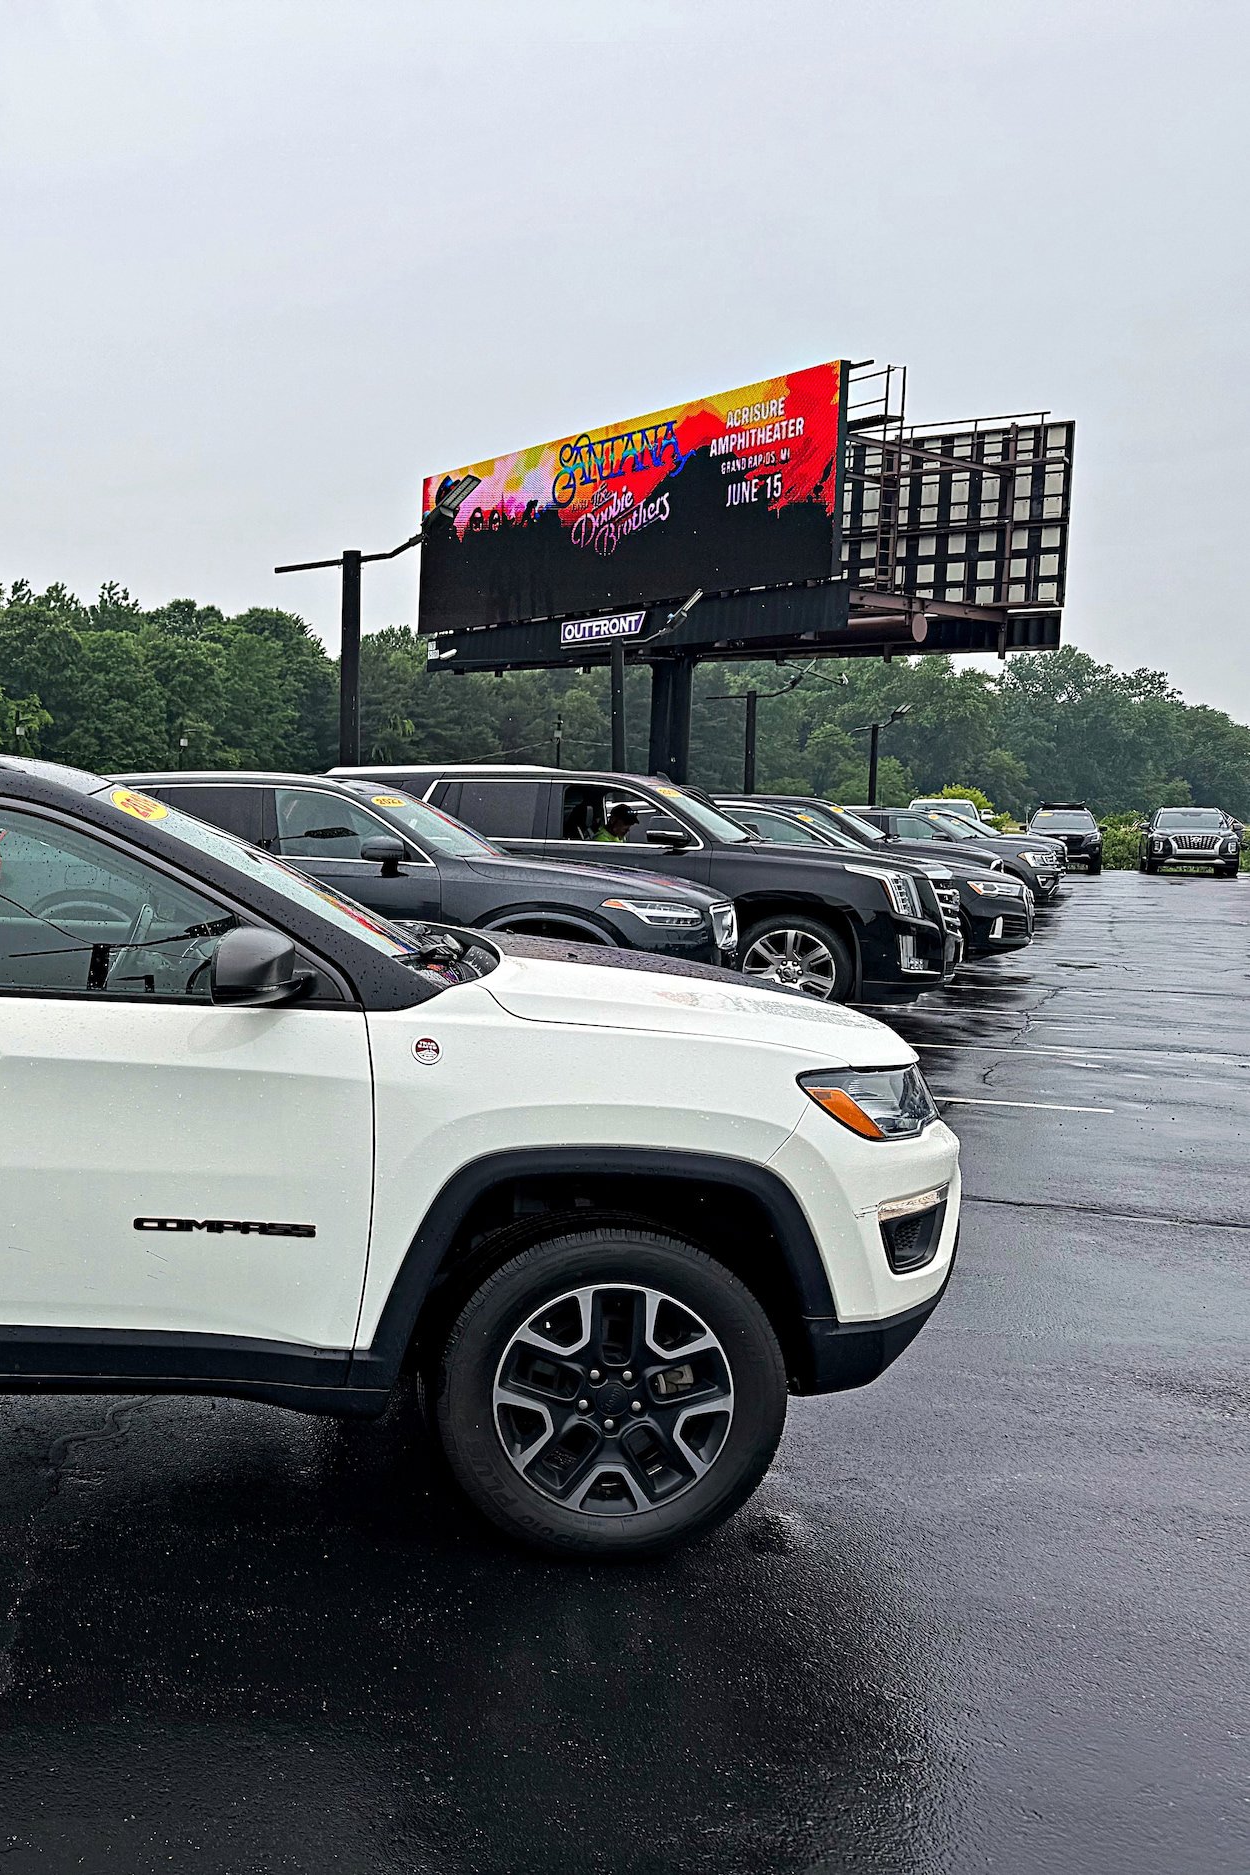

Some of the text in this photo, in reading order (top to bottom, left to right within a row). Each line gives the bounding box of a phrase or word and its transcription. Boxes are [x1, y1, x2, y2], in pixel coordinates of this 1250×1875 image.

[726, 396, 786, 429] ACRISURE
[710, 416, 805, 457] AMPHITHEATER
[550, 420, 696, 507] SANTANA
[721, 456, 747, 475] GRAND
[780, 447, 791, 461] MI
[726, 473, 783, 507] JUNE 15
[571, 485, 634, 548] Doobie
[594, 492, 671, 556] Brothers
[563, 615, 640, 640] OUTFRONT
[133, 1217, 317, 1238] COMPASS
